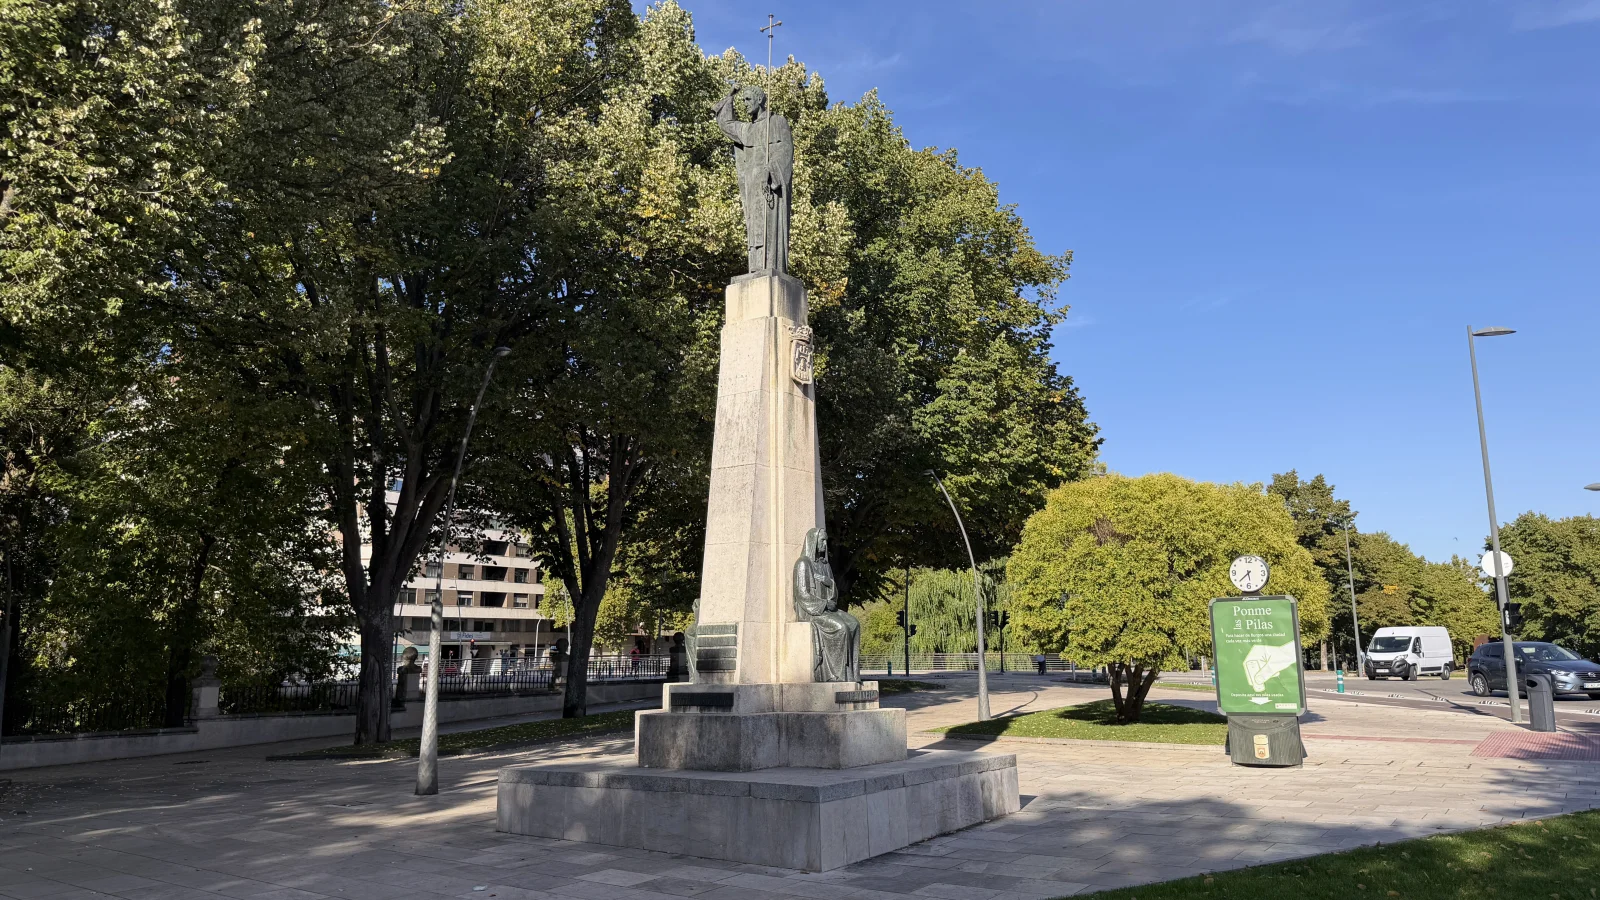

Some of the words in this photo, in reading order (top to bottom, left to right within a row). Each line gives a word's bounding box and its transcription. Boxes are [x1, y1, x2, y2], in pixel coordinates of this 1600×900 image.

[1233, 606, 1271, 616] Ponme
[1233, 620, 1242, 630] las
[1246, 619, 1273, 630] Pilas
